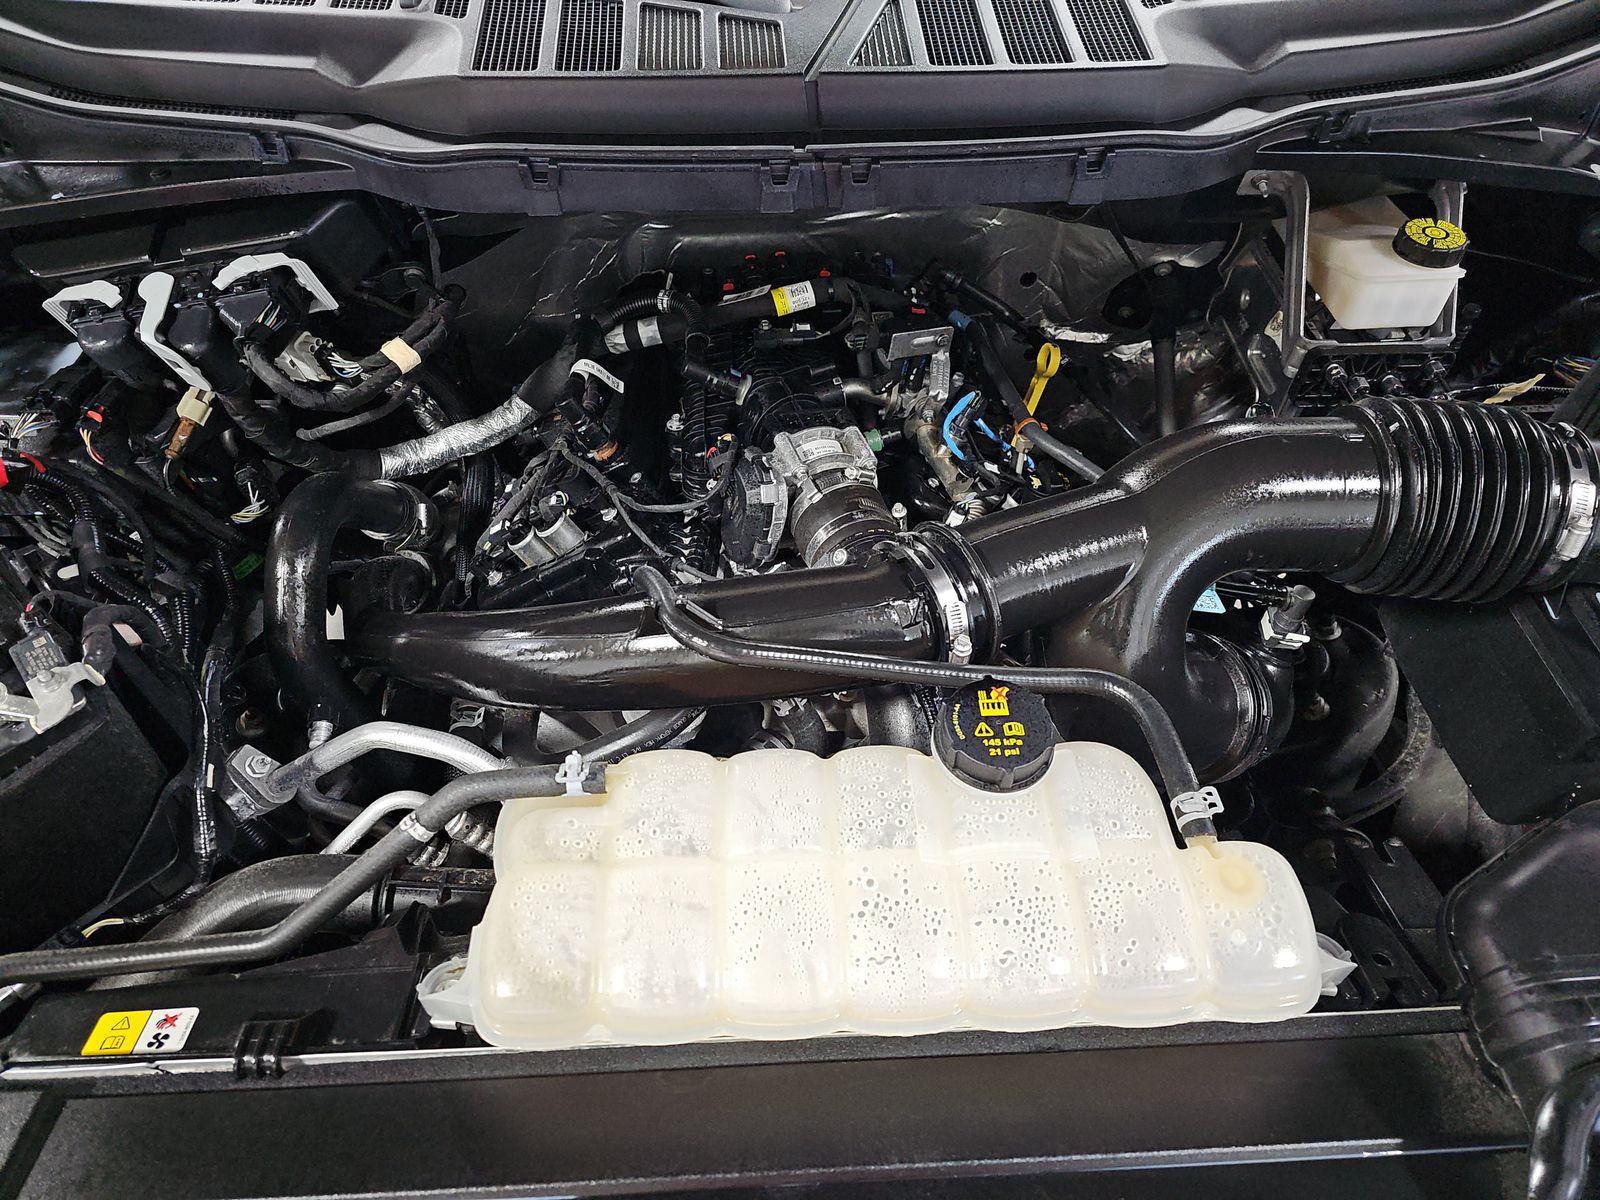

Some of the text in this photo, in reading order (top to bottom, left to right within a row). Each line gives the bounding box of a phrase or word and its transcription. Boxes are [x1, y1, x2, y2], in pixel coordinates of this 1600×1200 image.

[983, 738, 1023, 746] 145 kPa
[989, 747, 1020, 757] 21 psi
